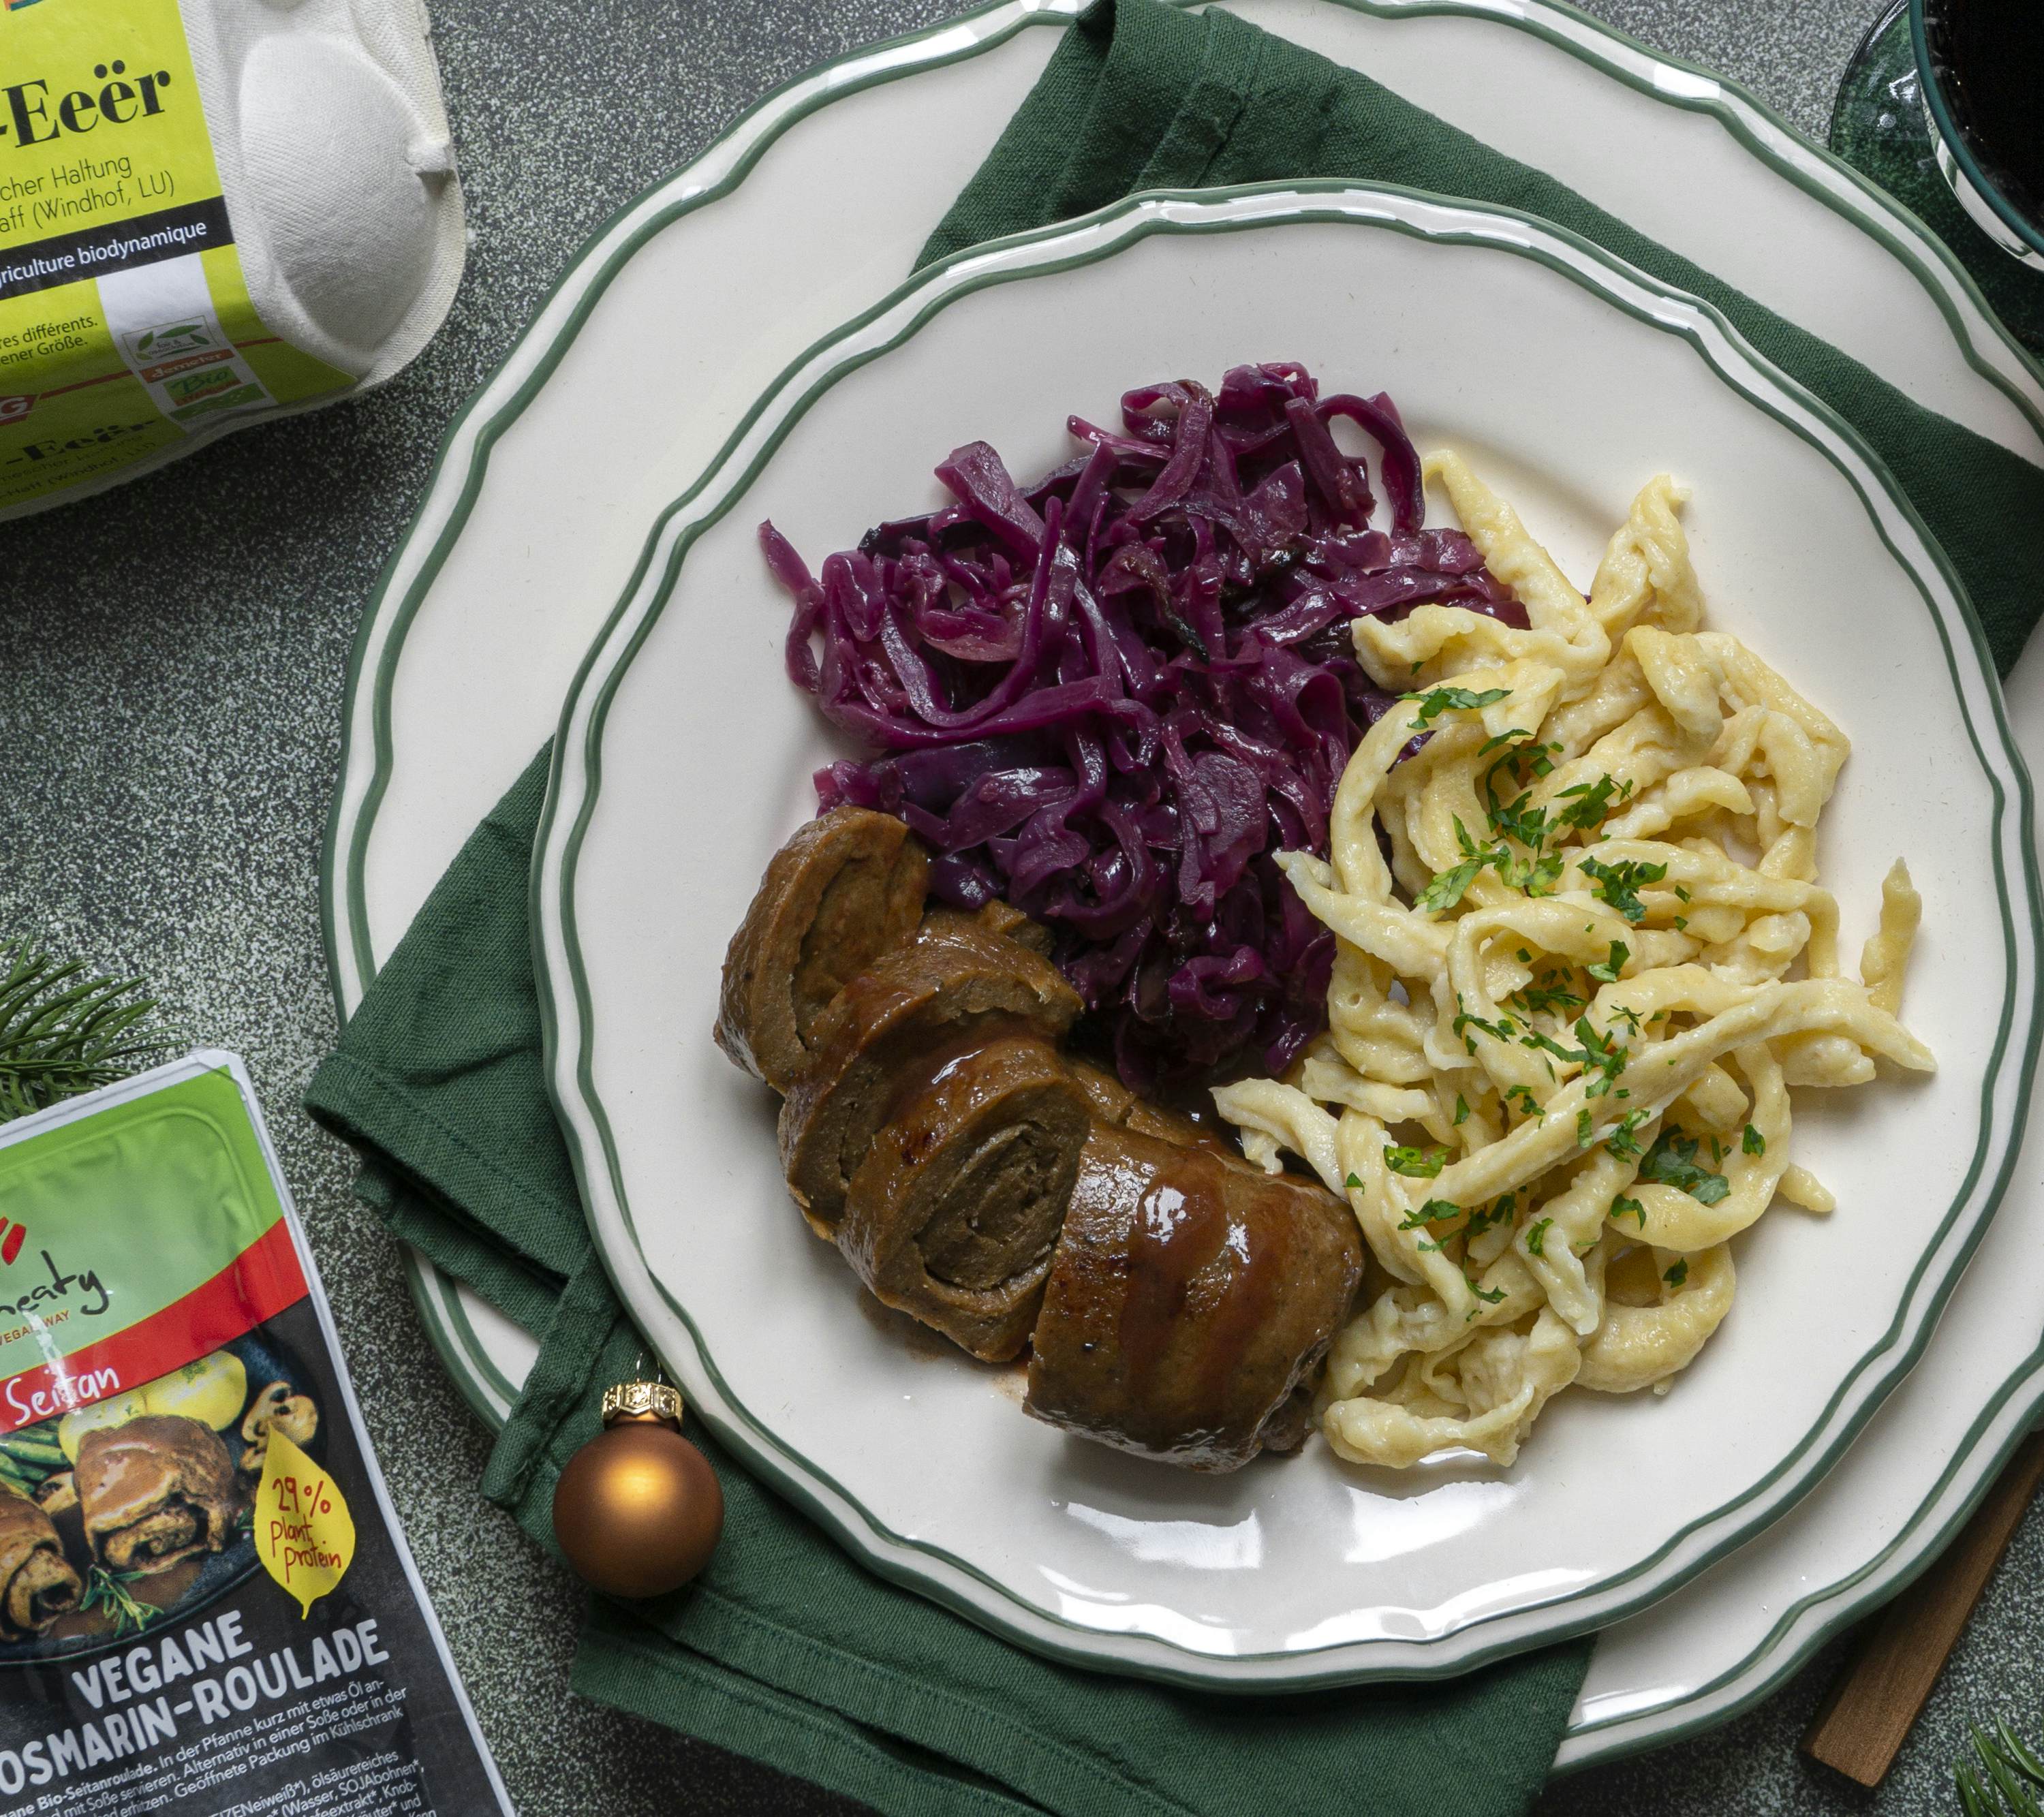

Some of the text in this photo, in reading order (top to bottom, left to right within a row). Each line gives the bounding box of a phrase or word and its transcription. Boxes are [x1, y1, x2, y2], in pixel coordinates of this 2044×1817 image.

[51, 157, 132, 189] Haltung
[33, 181, 131, 229] (Windhof,
[138, 170, 174, 198] LU)
[77, 222, 207, 265] biodynamique
[22, 316, 98, 343] différents.
[37, 335, 88, 356] Größe.
[43, 1309, 69, 1328] WAY
[5, 1367, 120, 1426] Seitan
[270, 1514, 313, 1558] plant
[284, 1538, 342, 1584] protein
[72, 1609, 253, 1709] VEGANE
[0, 1618, 390, 1795] OSMARIN-ROULADE
[36, 1762, 158, 1811] Bio-Seitanroulade.
[158, 1756, 174, 1769] In
[176, 1745, 200, 1762] der
[202, 1726, 253, 1752] Pfanne
[253, 1712, 285, 1732] kurz
[287, 1702, 311, 1720] mit
[312, 1690, 348, 1710] etwas
[348, 1681, 364, 1697] Öl
[365, 1679, 385, 1693] an-
[63, 1801, 87, 1817] mit
[86, 1791, 119, 1812] Soße
[119, 1773, 181, 1801] servieren.
[183, 1742, 251, 1778] Alternativ
[251, 1737, 268, 1750] in
[268, 1722, 305, 1744] einer
[306, 1709, 340, 1730] Soße
[341, 1700, 369, 1718] oder
[369, 1696, 384, 1709] in
[384, 1687, 407, 1704] der
[120, 1705, 404, 1817] erhitzen. Geöffnete Packung im Kühlschrank
[311, 1751, 399, 1789] ölsäurereiches
[382, 1778, 418, 1799] Knob-
[281, 1789, 338, 1817] (Wasser,
[400, 1792, 422, 1812] und
